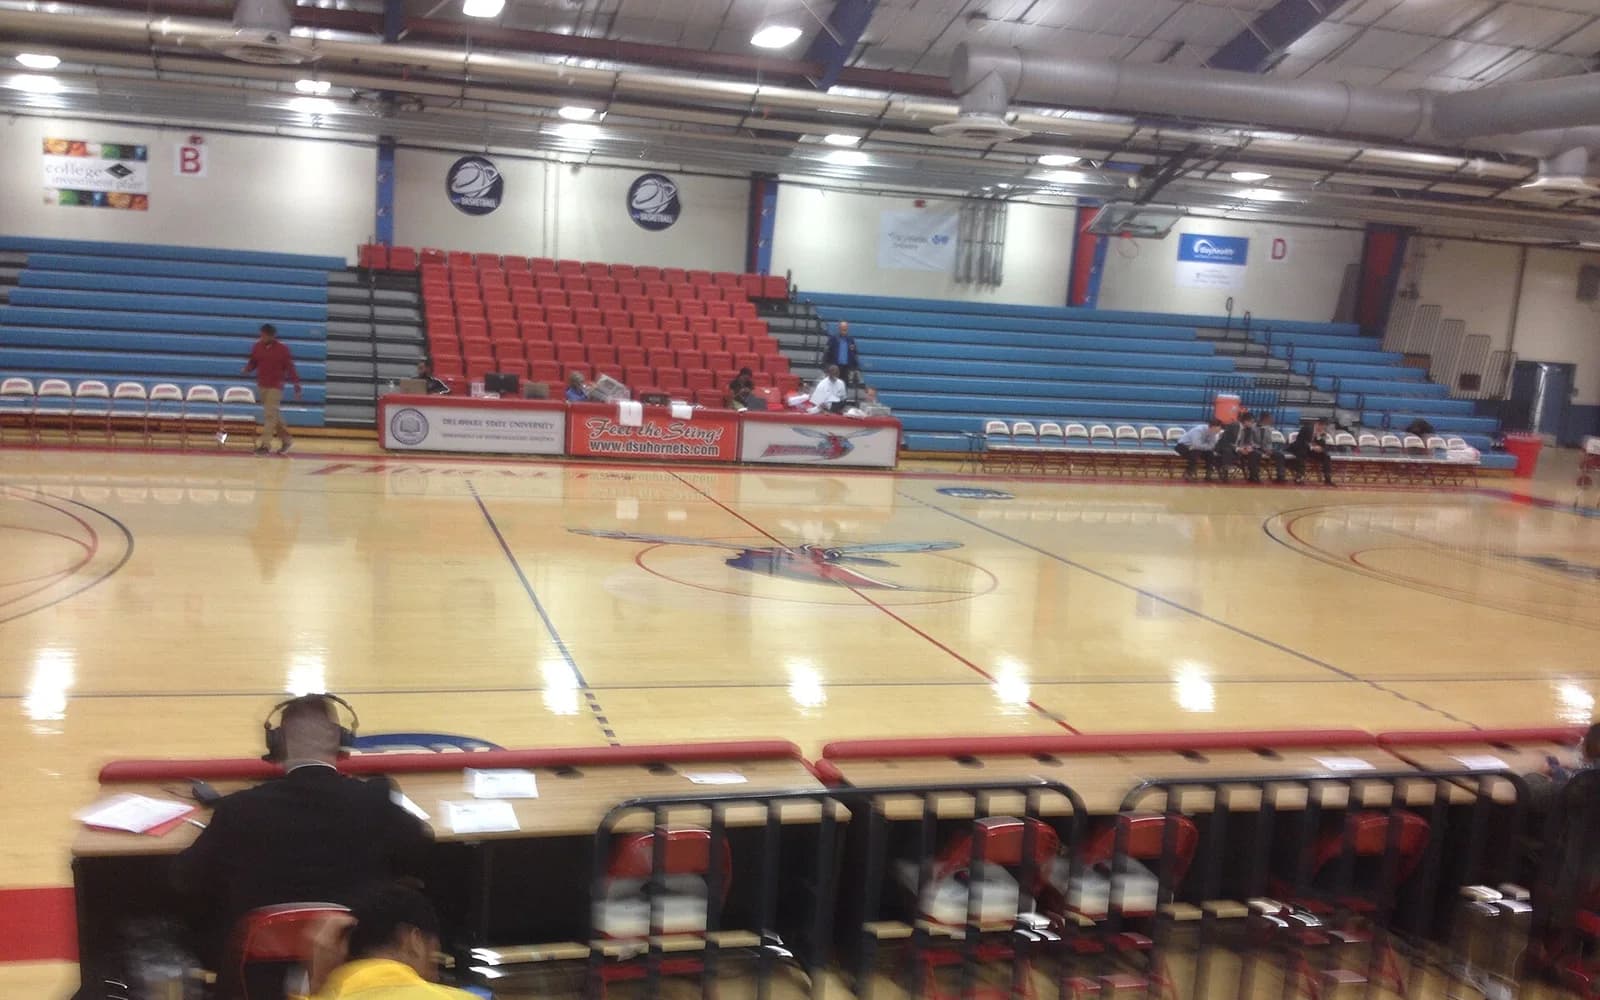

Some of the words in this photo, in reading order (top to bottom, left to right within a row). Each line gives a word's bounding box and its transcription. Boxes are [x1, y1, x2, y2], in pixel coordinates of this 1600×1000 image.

[46, 162, 102, 178] college
[180, 147, 201, 173] B
[1271, 238, 1287, 260] D
[486, 419, 506, 428] STATE
[509, 421, 555, 430] UNIVERSITY
[637, 421, 665, 439] the
[662, 421, 724, 445] Sting!
[589, 439, 720, 457] www.dsuhornets.com
